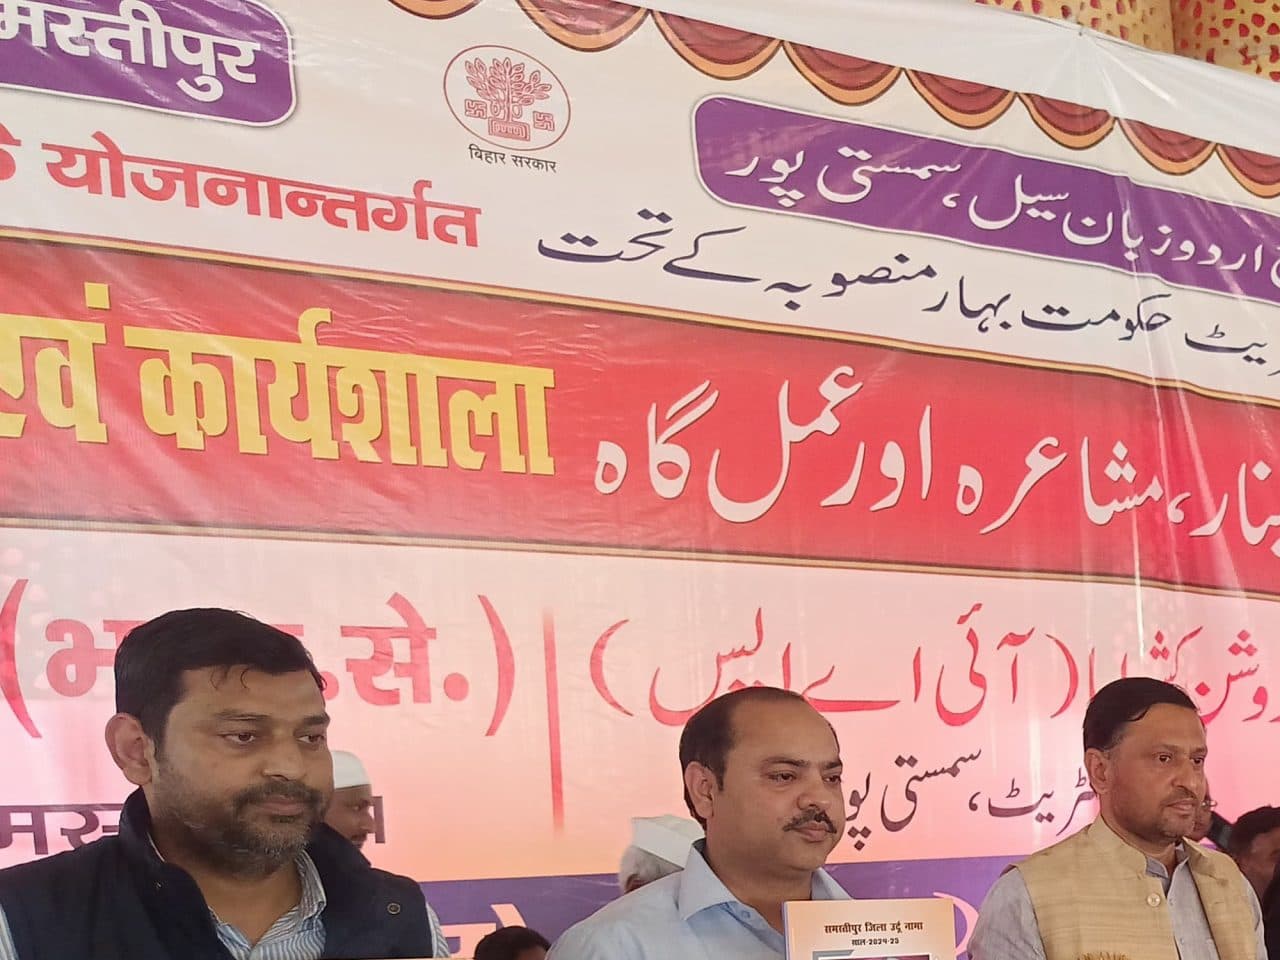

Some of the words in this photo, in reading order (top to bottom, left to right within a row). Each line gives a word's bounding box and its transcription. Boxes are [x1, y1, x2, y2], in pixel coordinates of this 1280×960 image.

[0, 0, 261, 102] मस्तीपुर
[41, 131, 482, 248] योजनान्तर्गत
[468, 143, 506, 165] बिहार
[511, 154, 557, 173] सरकार
[538, 208, 674, 263] تحت
[662, 225, 763, 283] کے
[922, 275, 1013, 333] بہار
[1021, 293, 1173, 342] حکومت
[123, 307, 557, 476] कार्यशाला
[594, 379, 720, 500] گاہ
[707, 365, 864, 523] عمل
[820, 404, 933, 512] اور
[956, 435, 1164, 535] مشاعرہ
